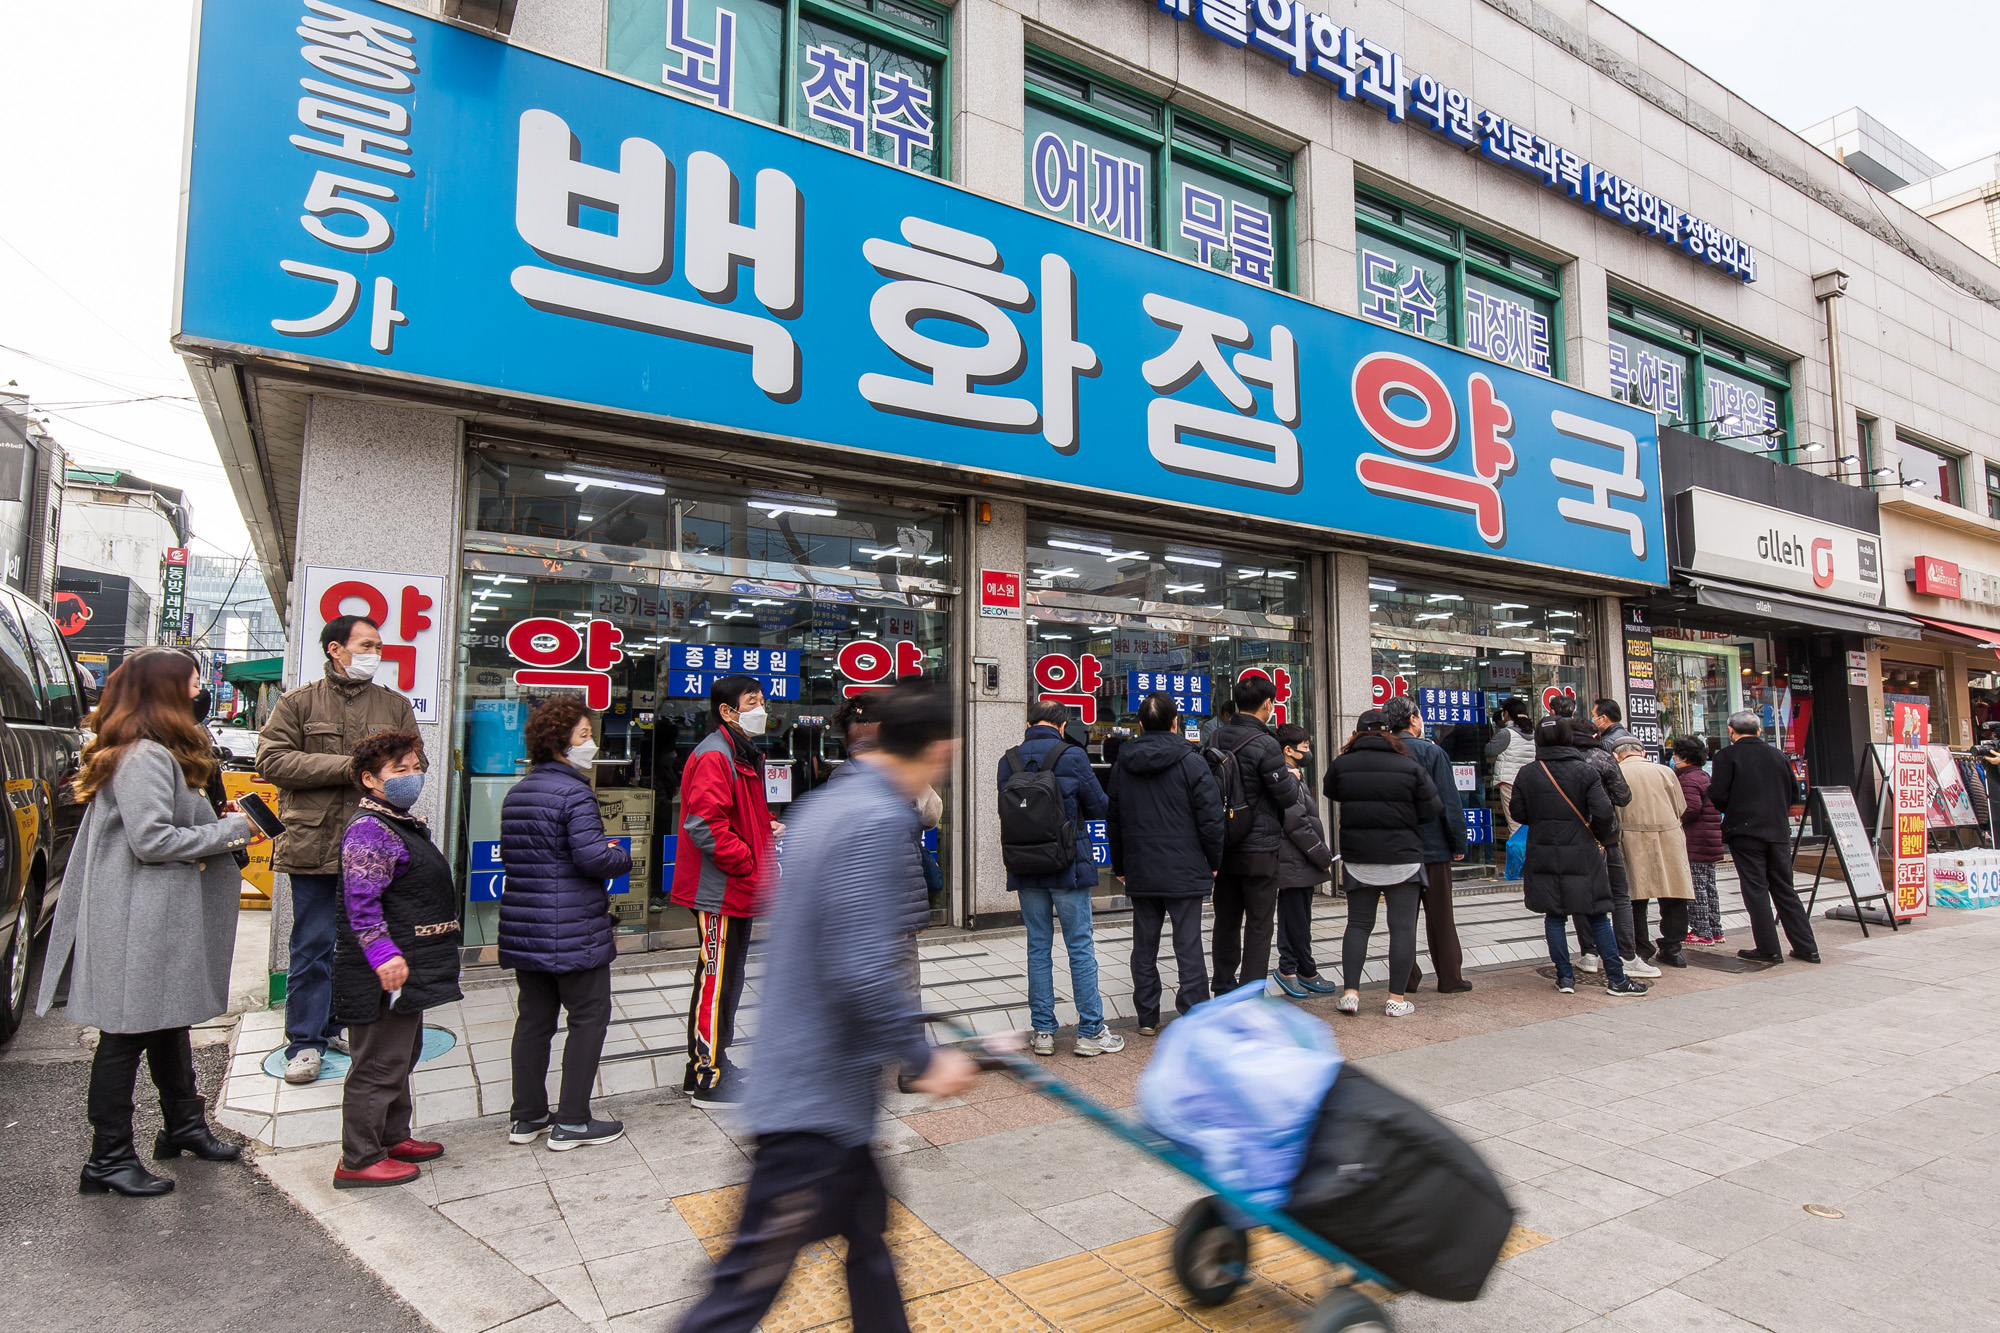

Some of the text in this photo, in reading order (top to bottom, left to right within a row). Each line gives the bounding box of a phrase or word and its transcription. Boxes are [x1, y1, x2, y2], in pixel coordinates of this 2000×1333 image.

[801, 44, 934, 168] 척추
[1409, 74, 1475, 143] 의원
[1032, 131, 1274, 286] 어깨 무릎
[1361, 248, 1552, 378] 도수 교정치료
[1708, 378, 1777, 451] 재활운동
[1757, 528, 1805, 567] olleh
[165, 566, 184, 620] 동방레져
[986, 582, 1015, 598] 에스원
[599, 593, 685, 620] 건강기능식품
[982, 606, 1008, 616] SECOM
[505, 616, 624, 712] 약
[684, 645, 788, 673] 종합병원
[1033, 652, 1103, 726] 약
[1137, 673, 1202, 693] 종합병원
[1426, 689, 1470, 705] 종합병원
[1631, 696, 1655, 714] 요금수납
[1427, 706, 1471, 722] 처방조제
[1899, 768, 1925, 788] 어르신
[1899, 789, 1925, 808] 통신료
[1901, 834, 1922, 855] 할인!
[1898, 864, 1925, 886] 효도폰
[1898, 886, 1915, 909] 무료
